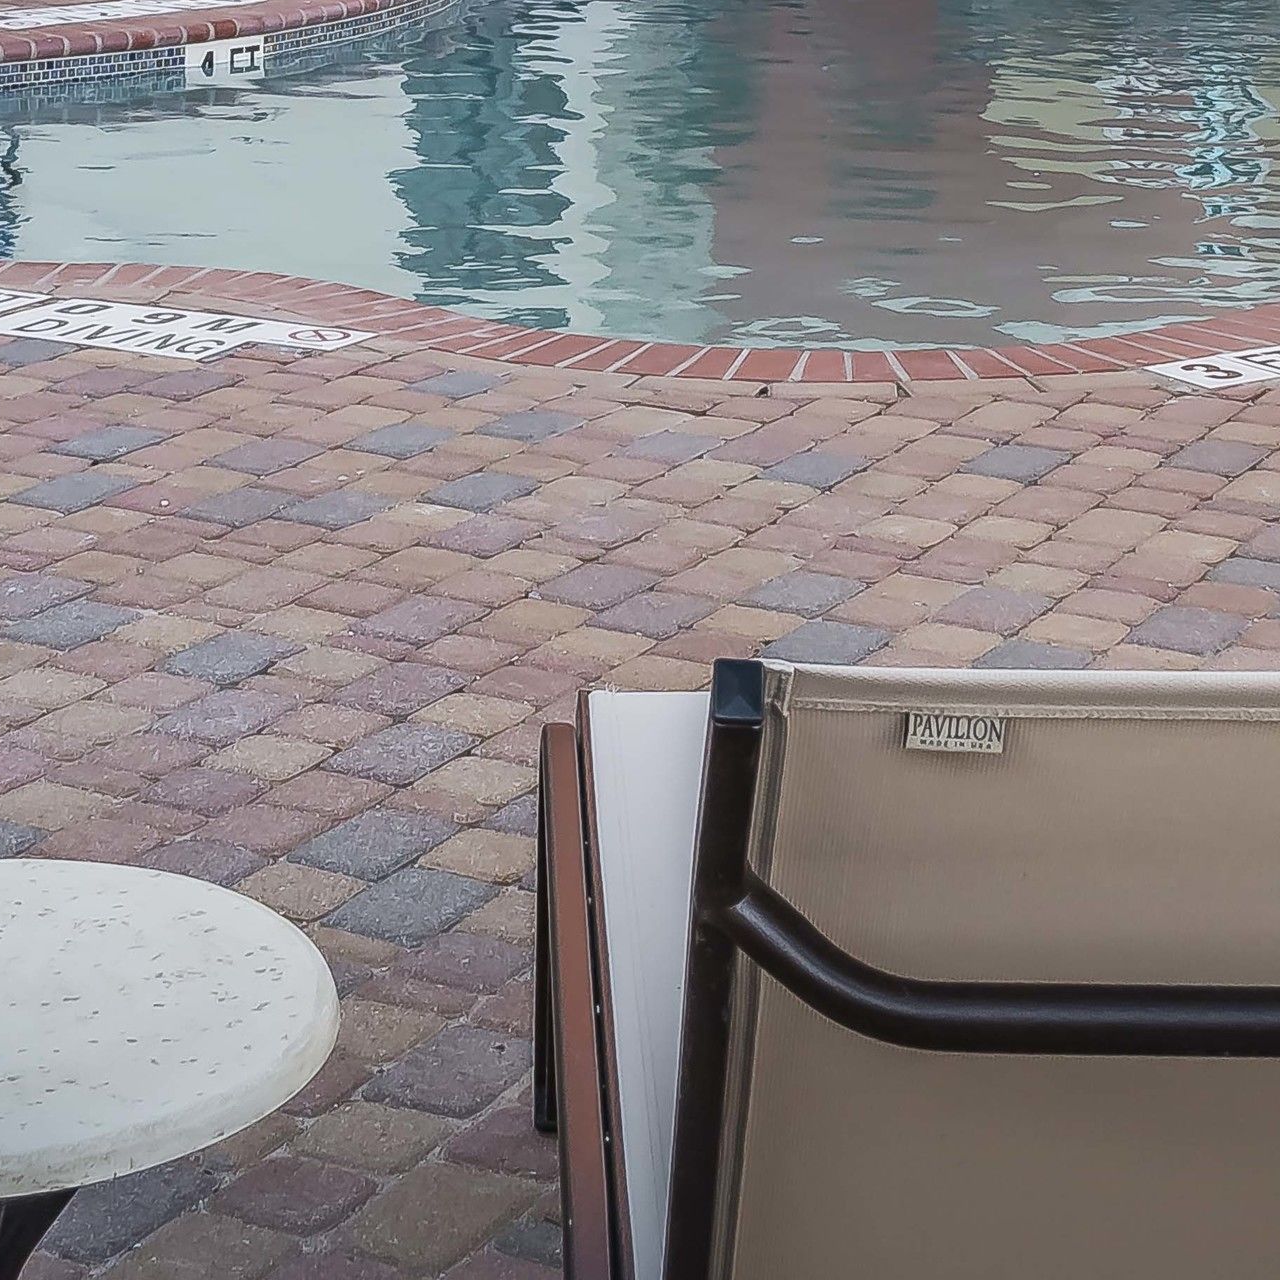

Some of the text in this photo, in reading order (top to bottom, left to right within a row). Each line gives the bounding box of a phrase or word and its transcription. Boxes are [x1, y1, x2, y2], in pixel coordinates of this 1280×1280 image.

[10, 318, 226, 355] DIVING
[910, 713, 1006, 742] PAVILION
[920, 739, 949, 748] MADE
[954, 740, 966, 748] IN
